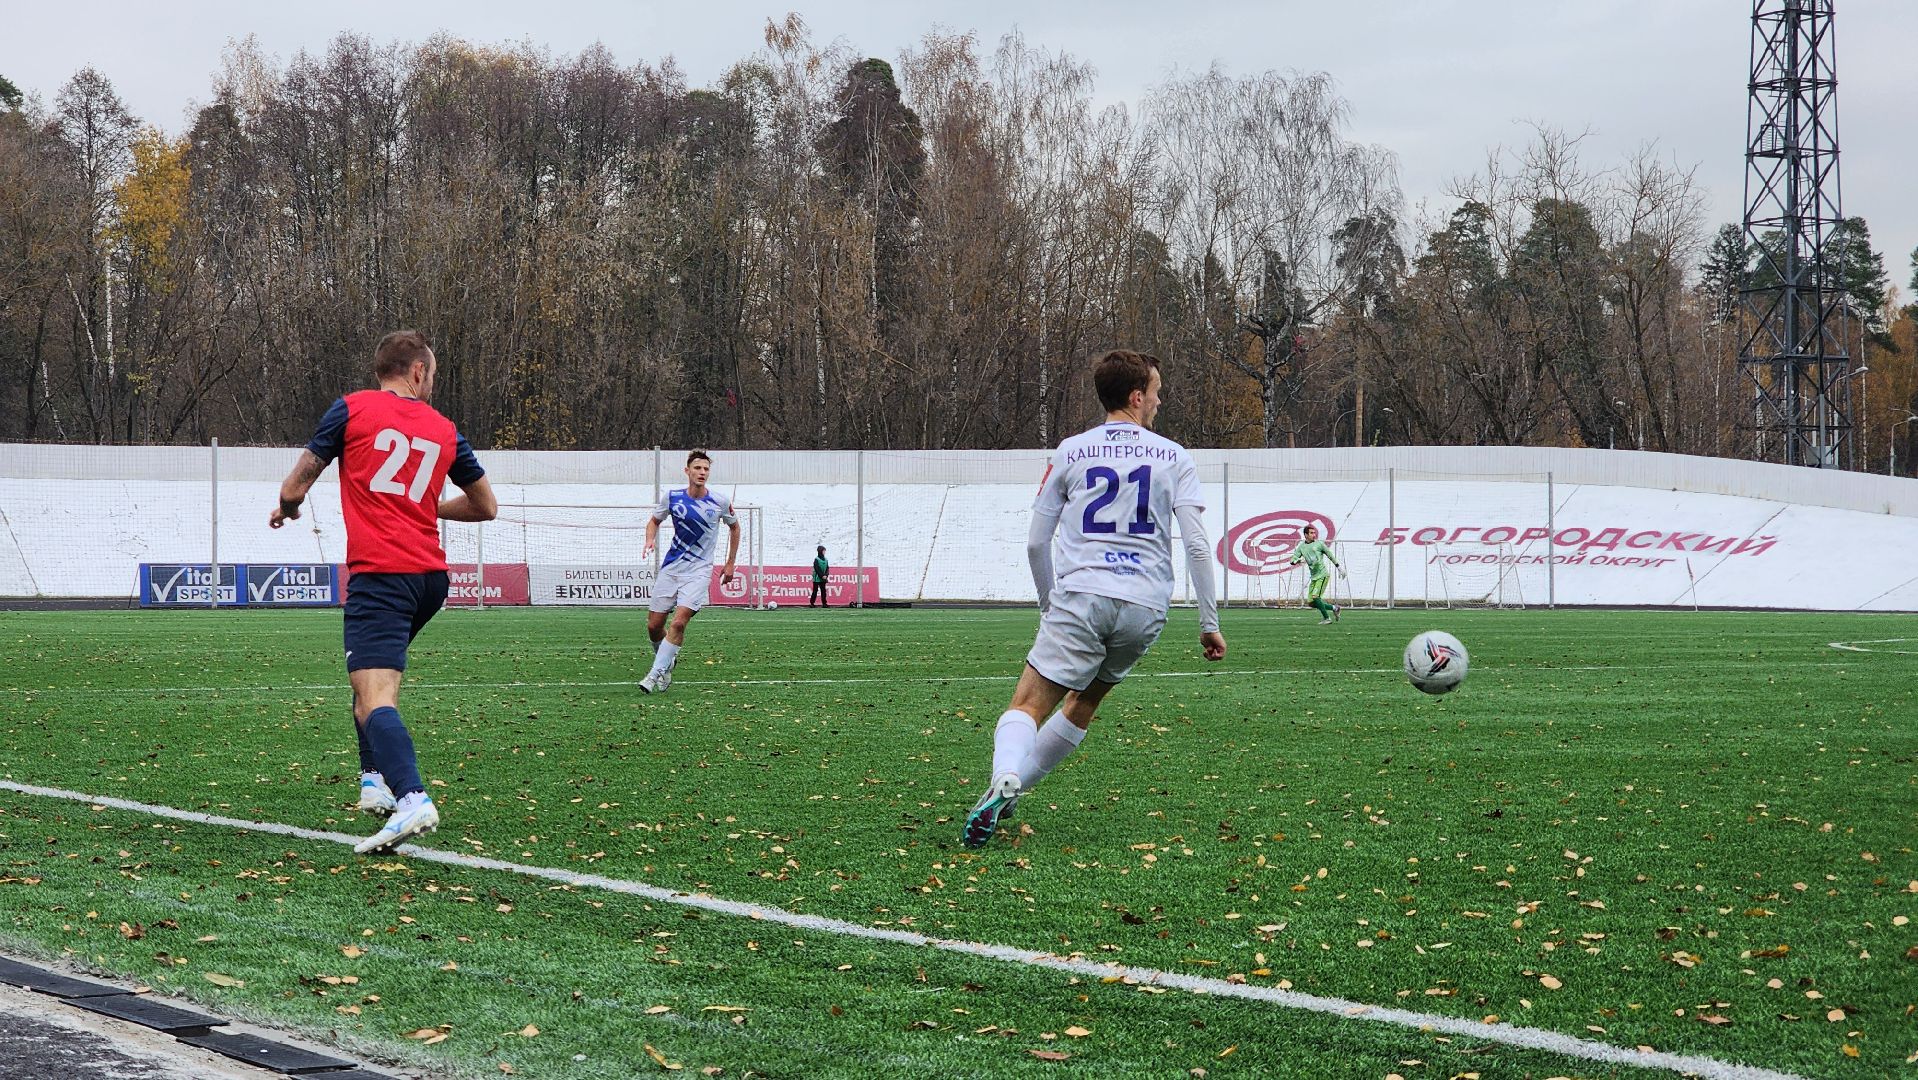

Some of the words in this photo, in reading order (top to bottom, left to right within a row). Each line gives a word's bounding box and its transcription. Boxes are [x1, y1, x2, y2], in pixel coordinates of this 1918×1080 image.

[1067, 446, 1177, 464] КАШПЕРСКИЙ
[370, 428, 441, 503] 27
[1083, 465, 1155, 534] 21
[1374, 527, 1777, 556] БОГОРОДСКИЙ
[1428, 552, 1588, 564] ГОРОДСКОЙ
[1590, 555, 1675, 567] ОКРУГ
[451, 572, 480, 583] МЯ
[565, 570, 612, 580] БИЛЕТЫ
[617, 570, 634, 580] НА
[638, 570, 653, 580] СА
[800, 574, 870, 584] ТРСЛЯЦИ
[276, 588, 328, 600] SPORT
[448, 586, 501, 597] ЕКОМ
[633, 585, 652, 598] BIL
